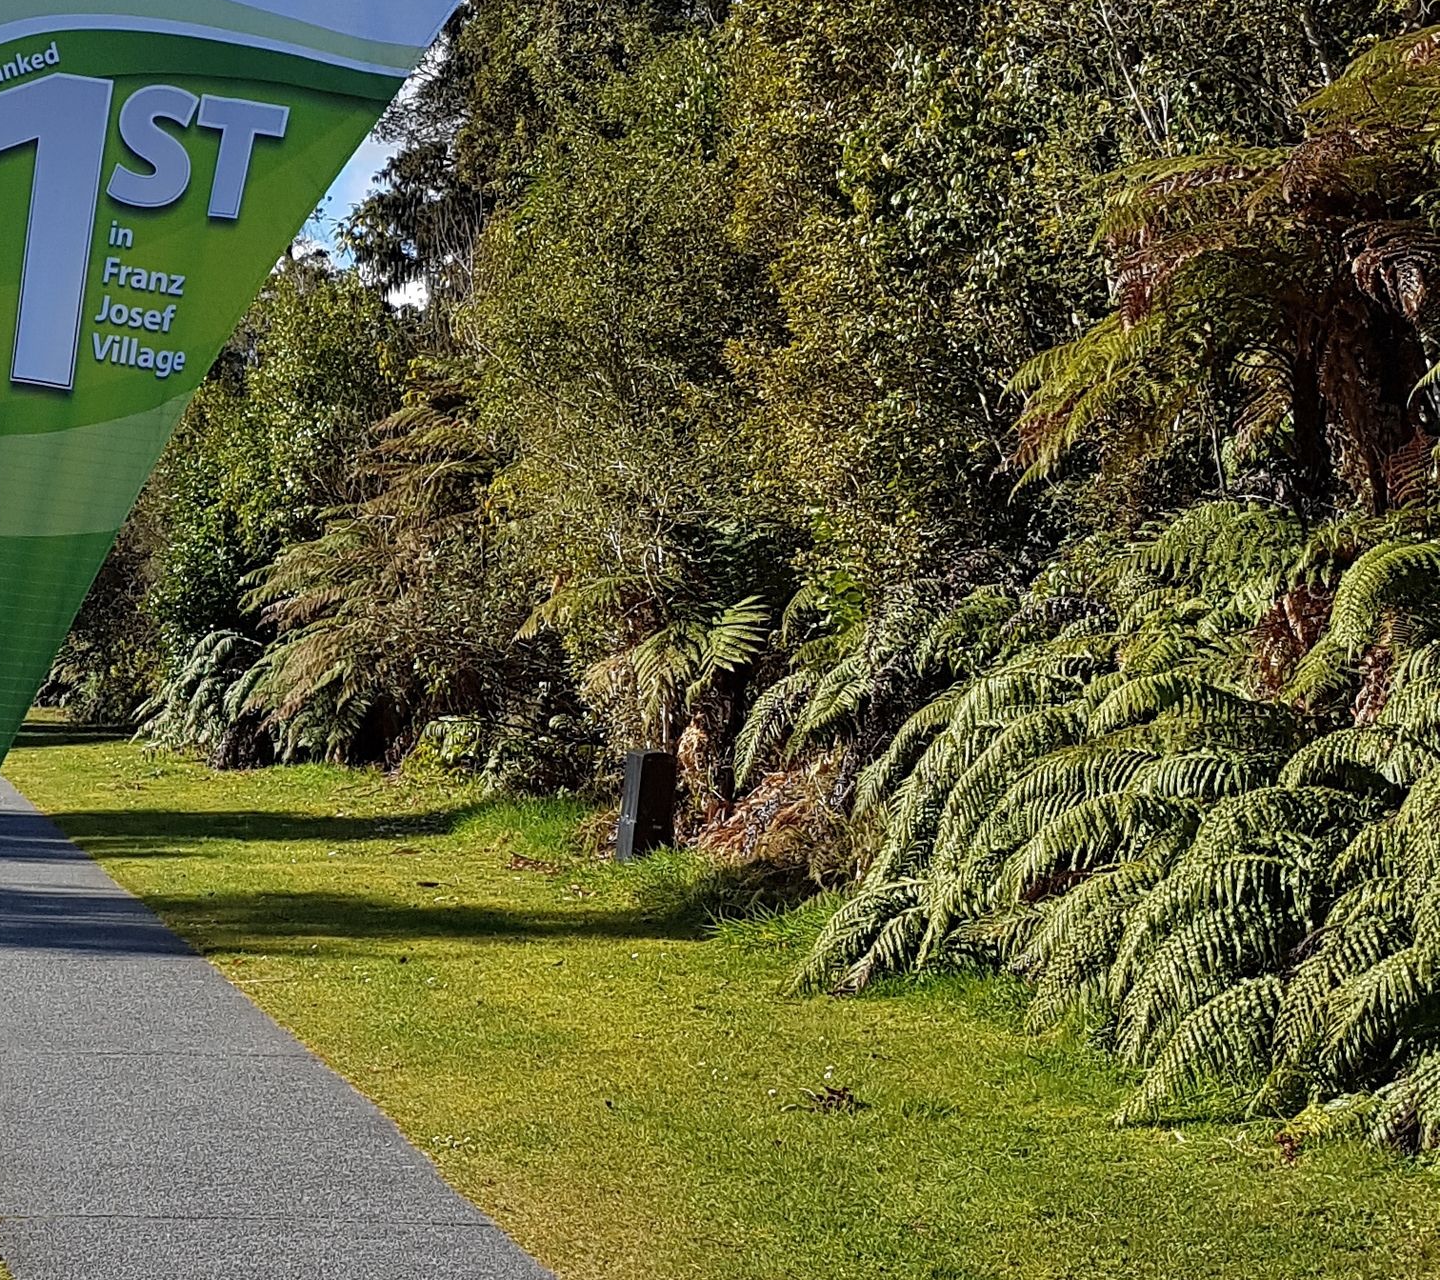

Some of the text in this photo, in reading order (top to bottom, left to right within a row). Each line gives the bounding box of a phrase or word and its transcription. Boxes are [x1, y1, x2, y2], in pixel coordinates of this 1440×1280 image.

[107, 220, 134, 249] in
[101, 256, 186, 296] Franz
[94, 295, 177, 333] Josef
[91, 332, 187, 378] Village
